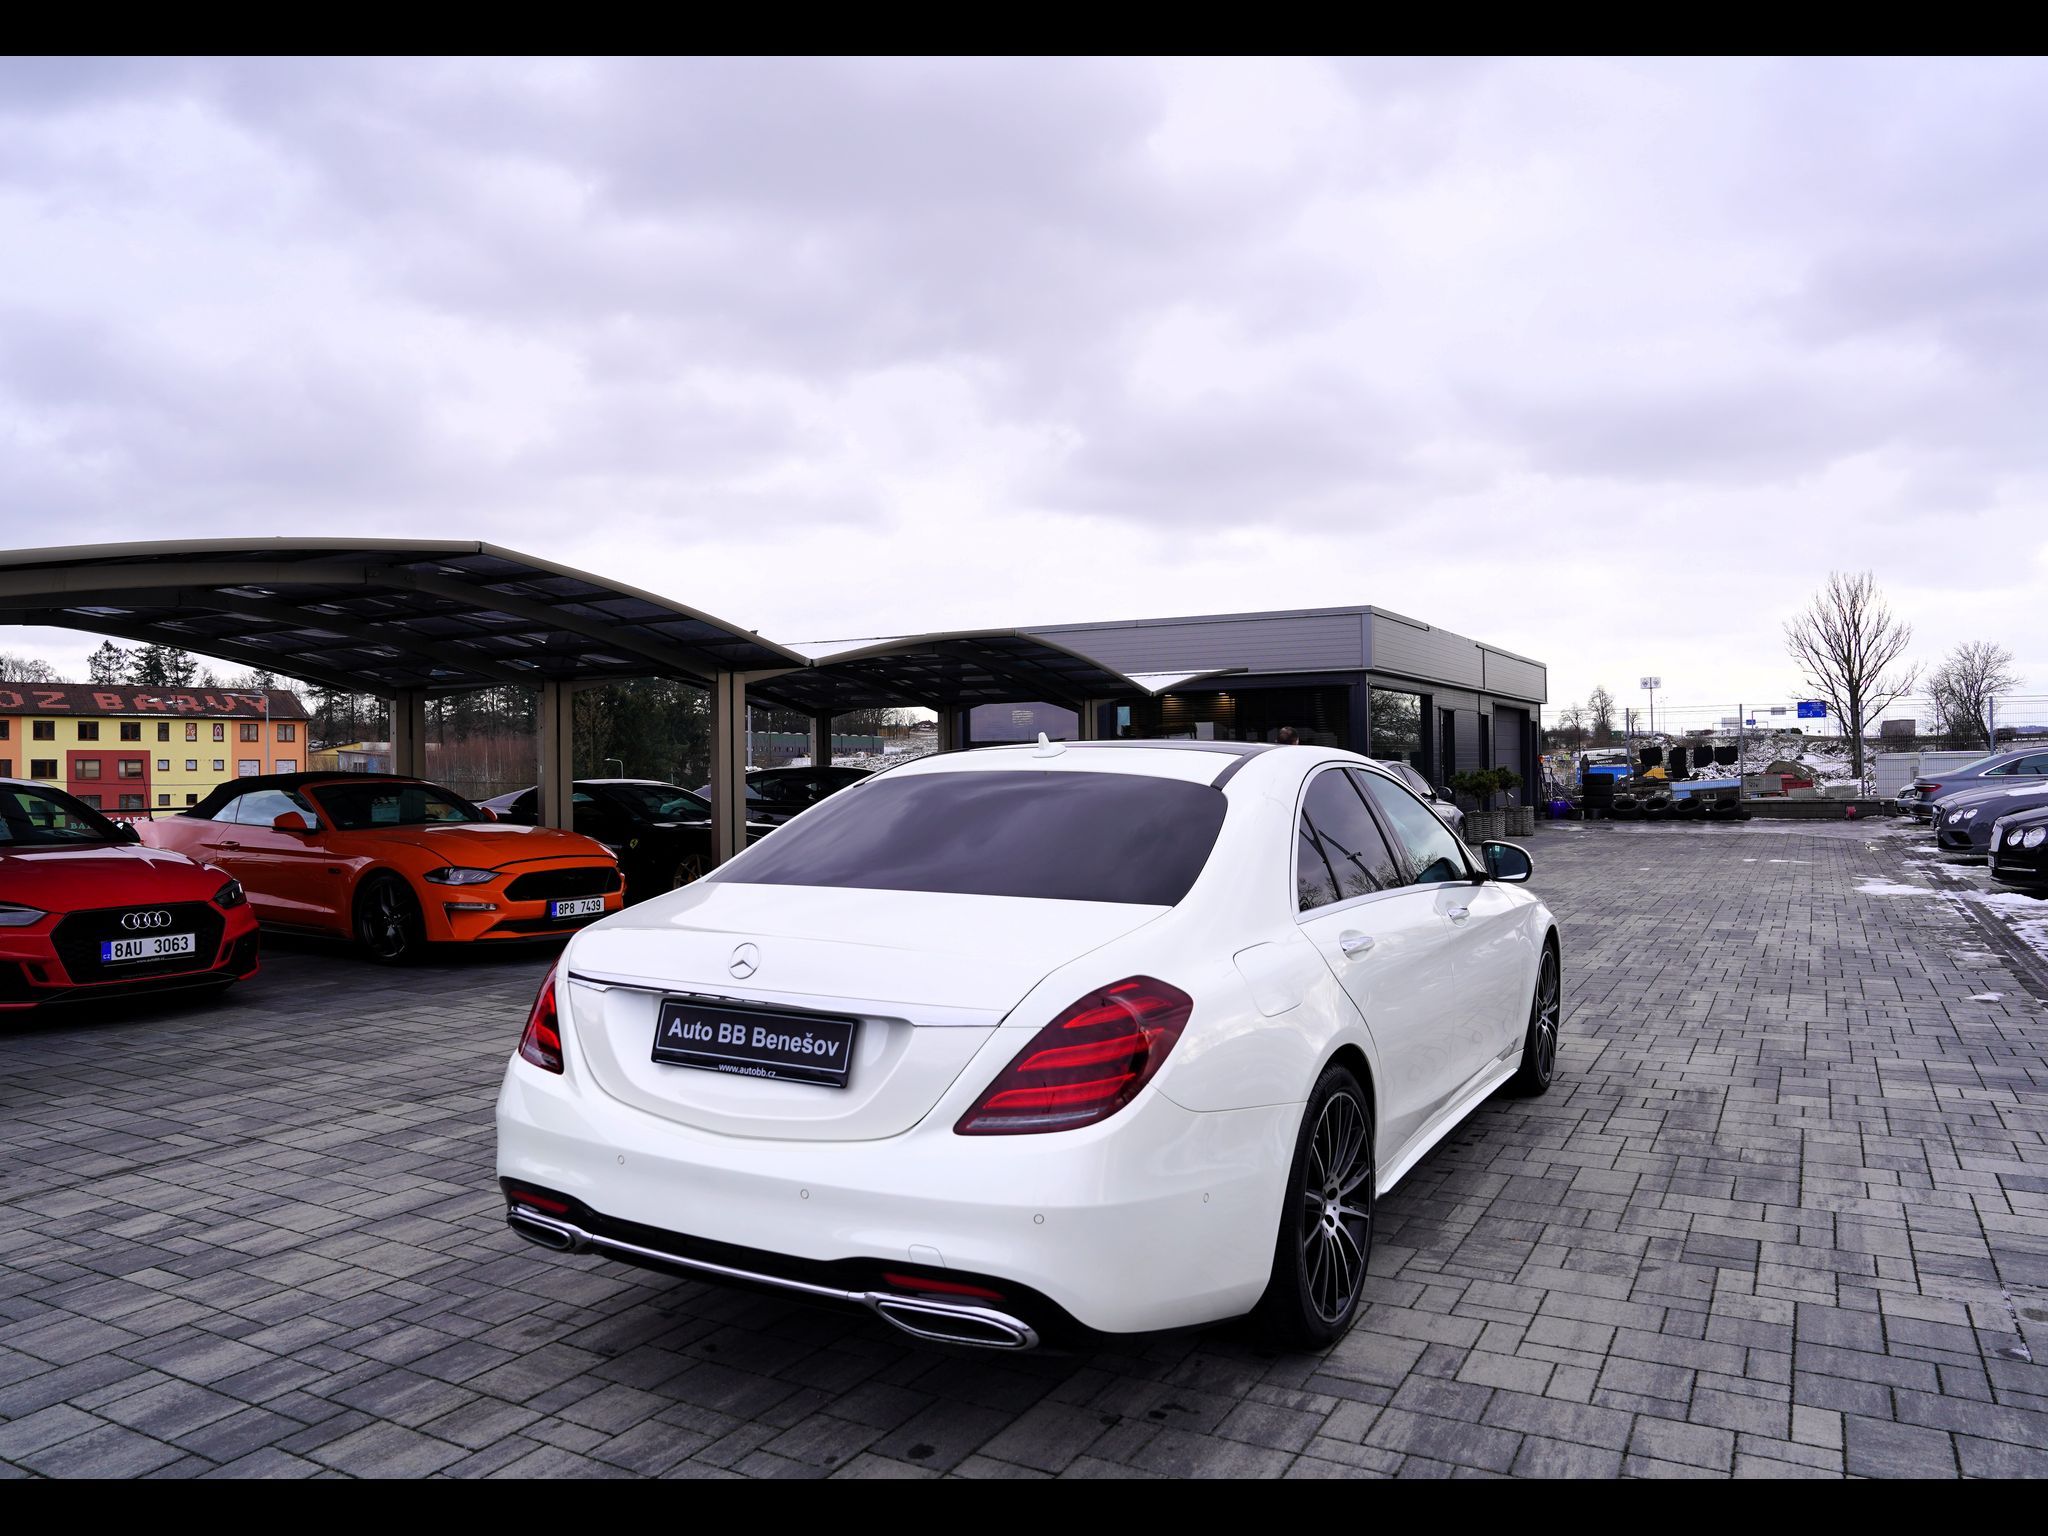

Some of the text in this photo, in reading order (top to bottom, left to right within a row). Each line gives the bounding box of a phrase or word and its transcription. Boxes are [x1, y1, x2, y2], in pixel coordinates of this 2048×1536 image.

[92, 692, 267, 713] BARVY
[558, 903, 575, 915] 8P8
[581, 900, 601, 912] 7439
[114, 936, 189, 958] 8AU 3063
[667, 1017, 840, 1056] Auto BB Benešov
[718, 1063, 777, 1078] www.autobb.cz
